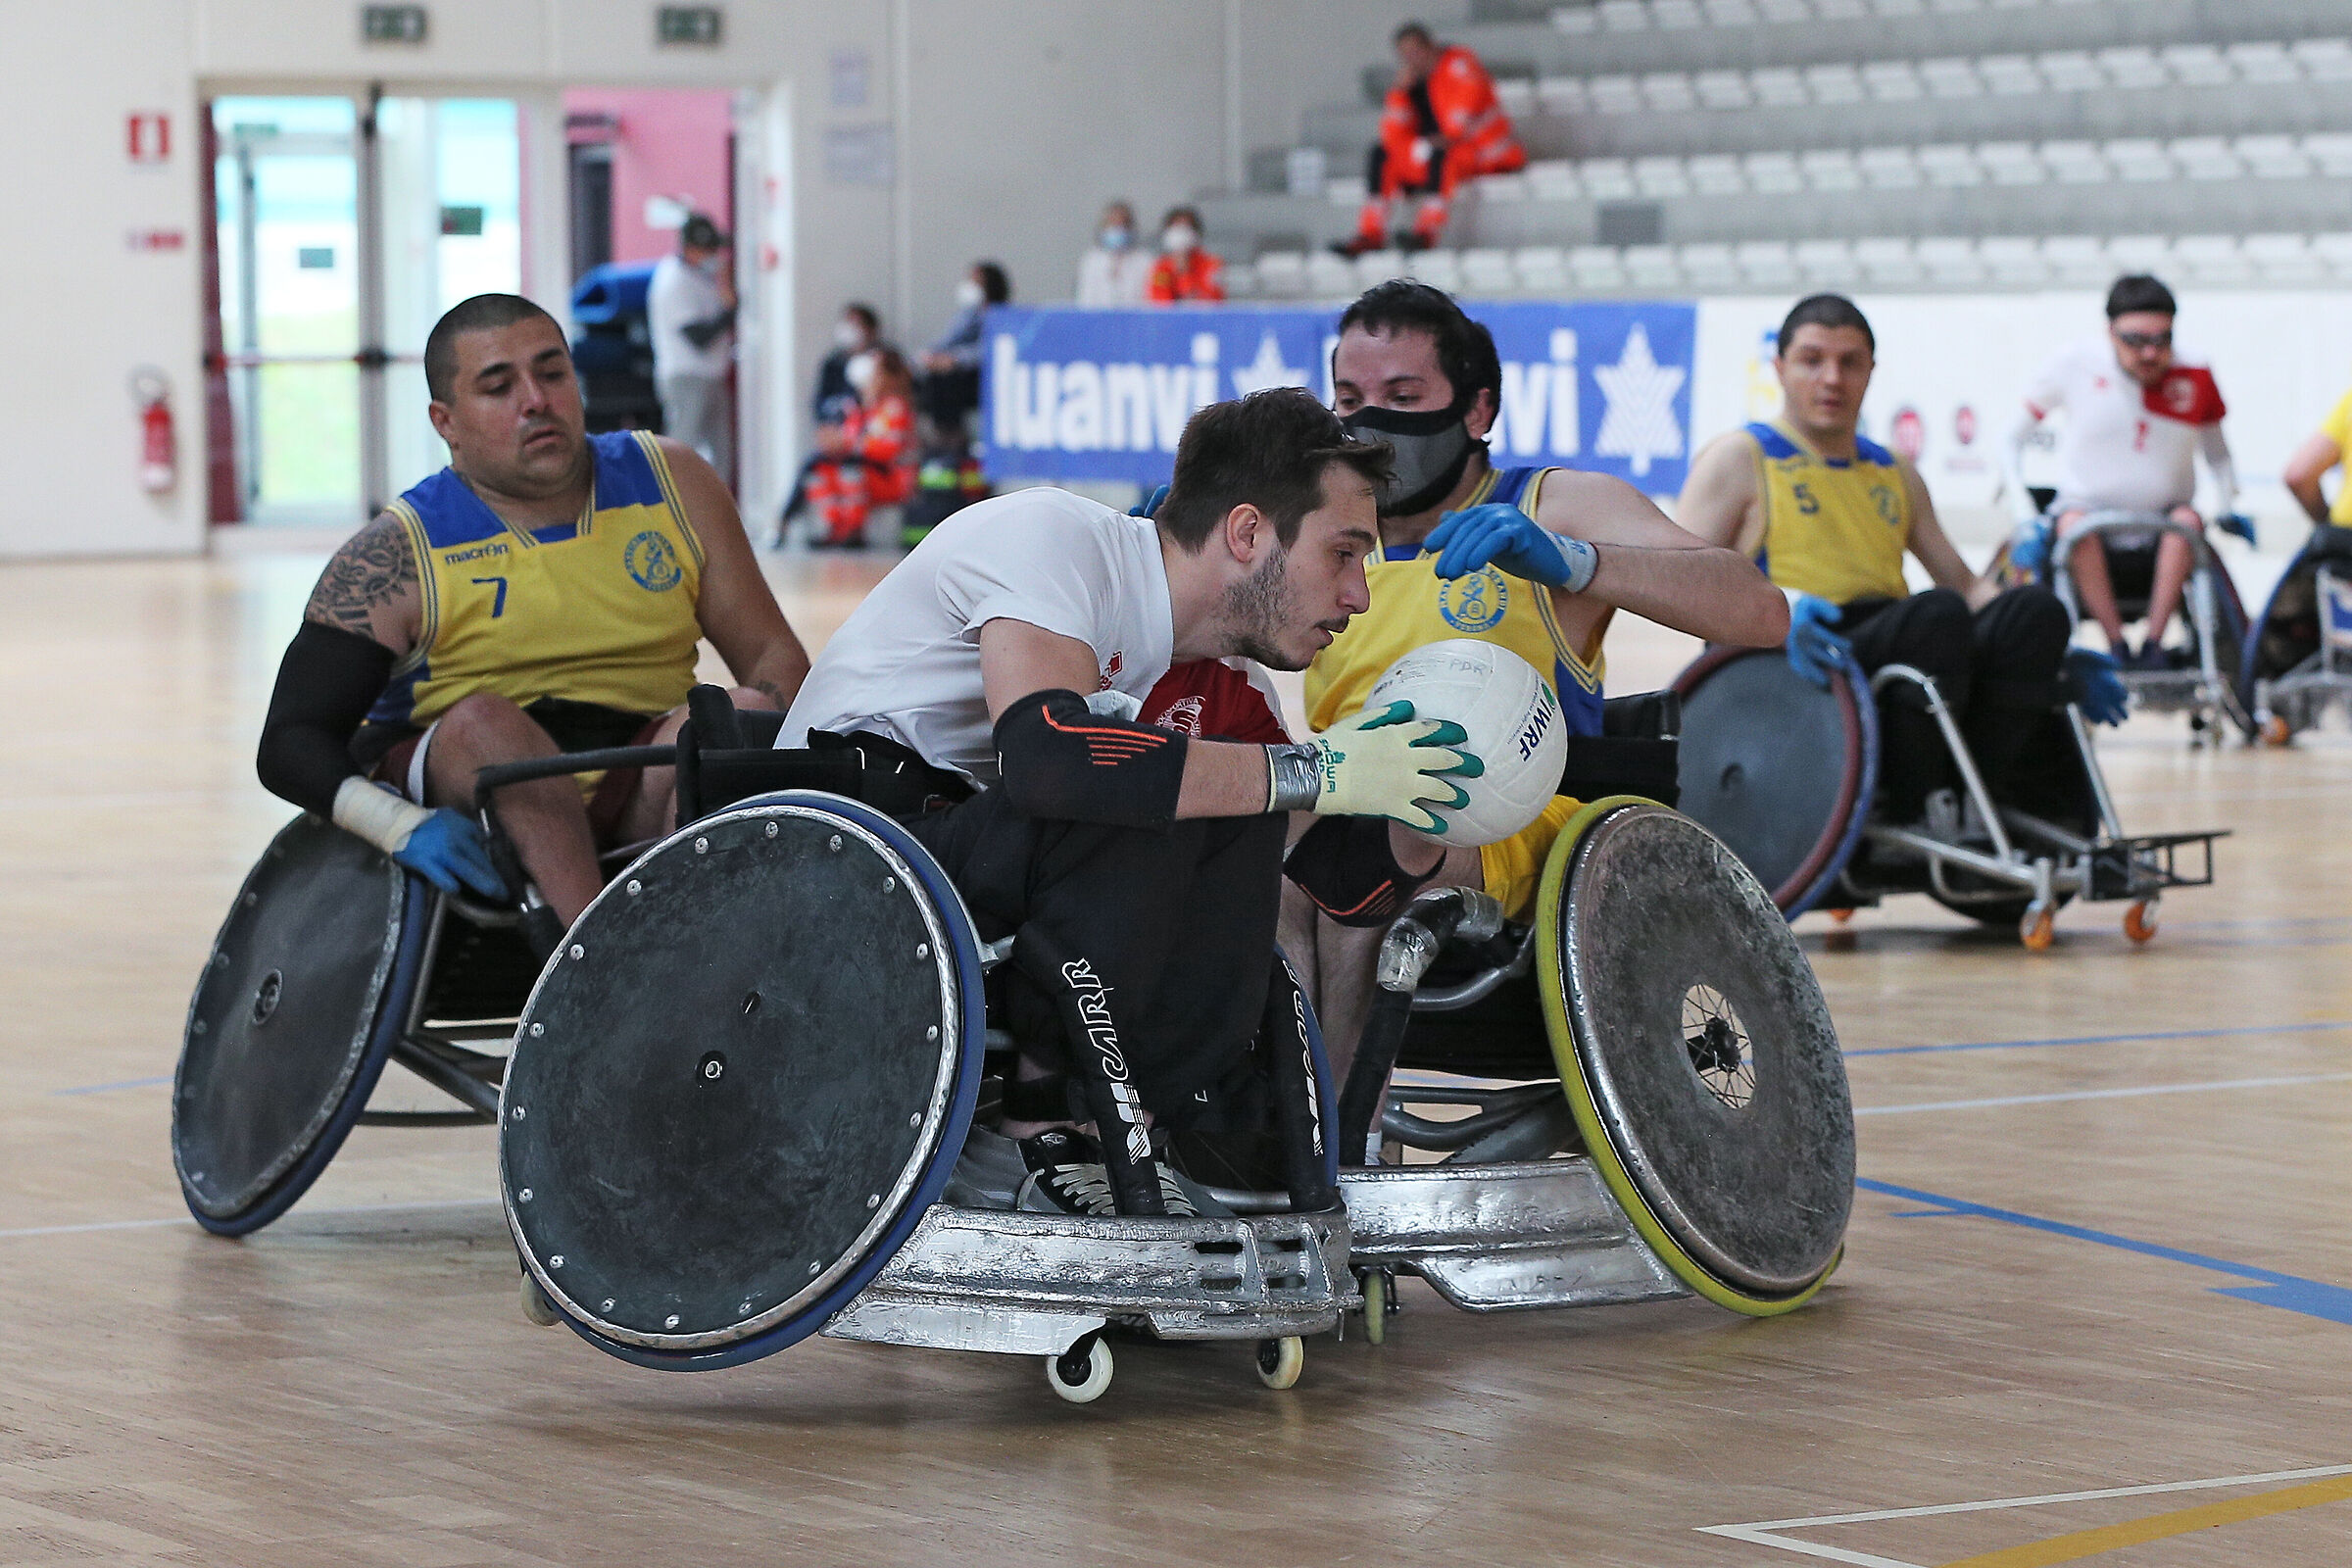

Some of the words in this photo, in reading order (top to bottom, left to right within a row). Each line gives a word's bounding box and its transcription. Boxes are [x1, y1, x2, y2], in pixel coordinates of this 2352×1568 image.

[993, 333, 1219, 453] luanvi
[1792, 482, 1820, 515] 5
[445, 543, 508, 565] macron
[471, 576, 508, 619] 7
[1519, 698, 1553, 762] IWRF
[1317, 738, 1336, 794] SHOWA
